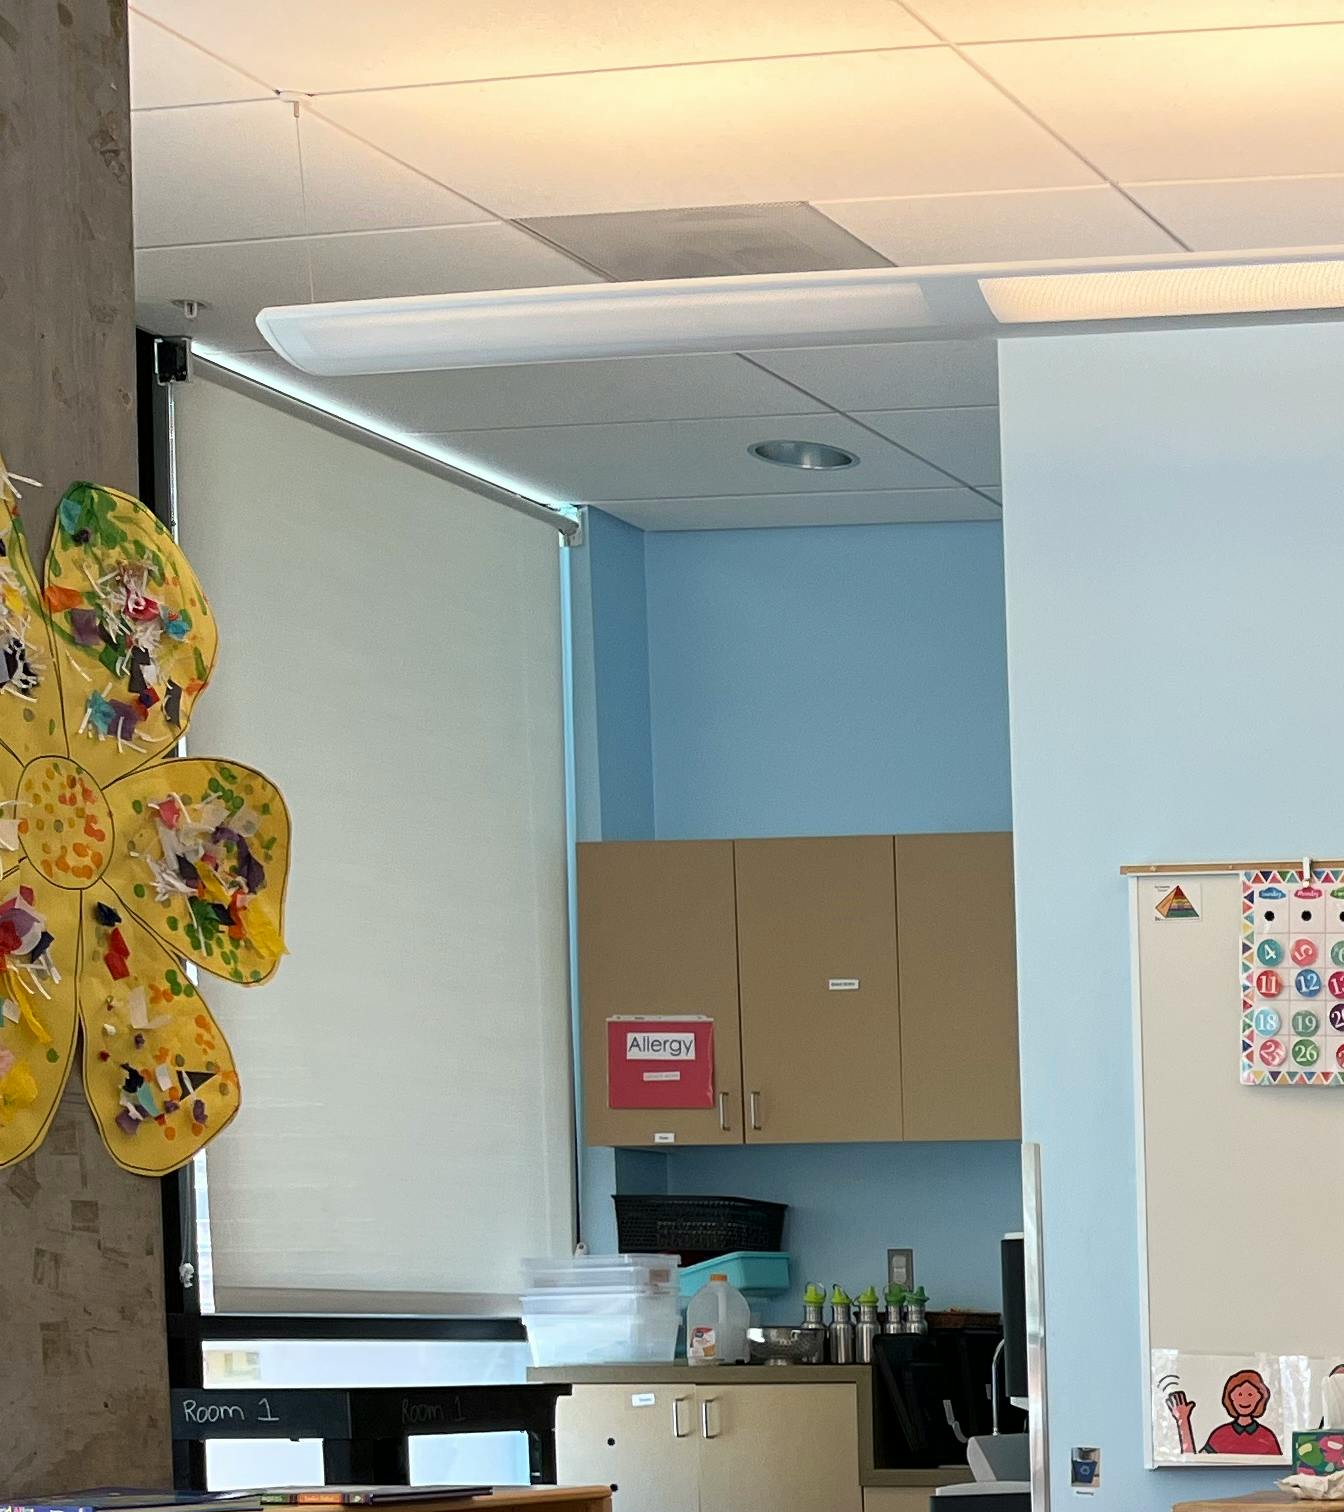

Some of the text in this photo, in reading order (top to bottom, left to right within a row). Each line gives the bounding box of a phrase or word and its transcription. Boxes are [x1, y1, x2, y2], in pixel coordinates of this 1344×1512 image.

[1264, 945, 1277, 960] 4
[1295, 947, 1313, 961] 5
[1260, 977, 1278, 993] 11
[1299, 975, 1318, 991] 12
[1258, 1015, 1277, 1030] 18
[1295, 1016, 1316, 1031] 19
[628, 1036, 693, 1056] Allergy
[1261, 1043, 1284, 1063] 25
[1295, 1046, 1317, 1062] 26
[183, 1398, 280, 1423] Room 1
[401, 1400, 444, 1423] Room
